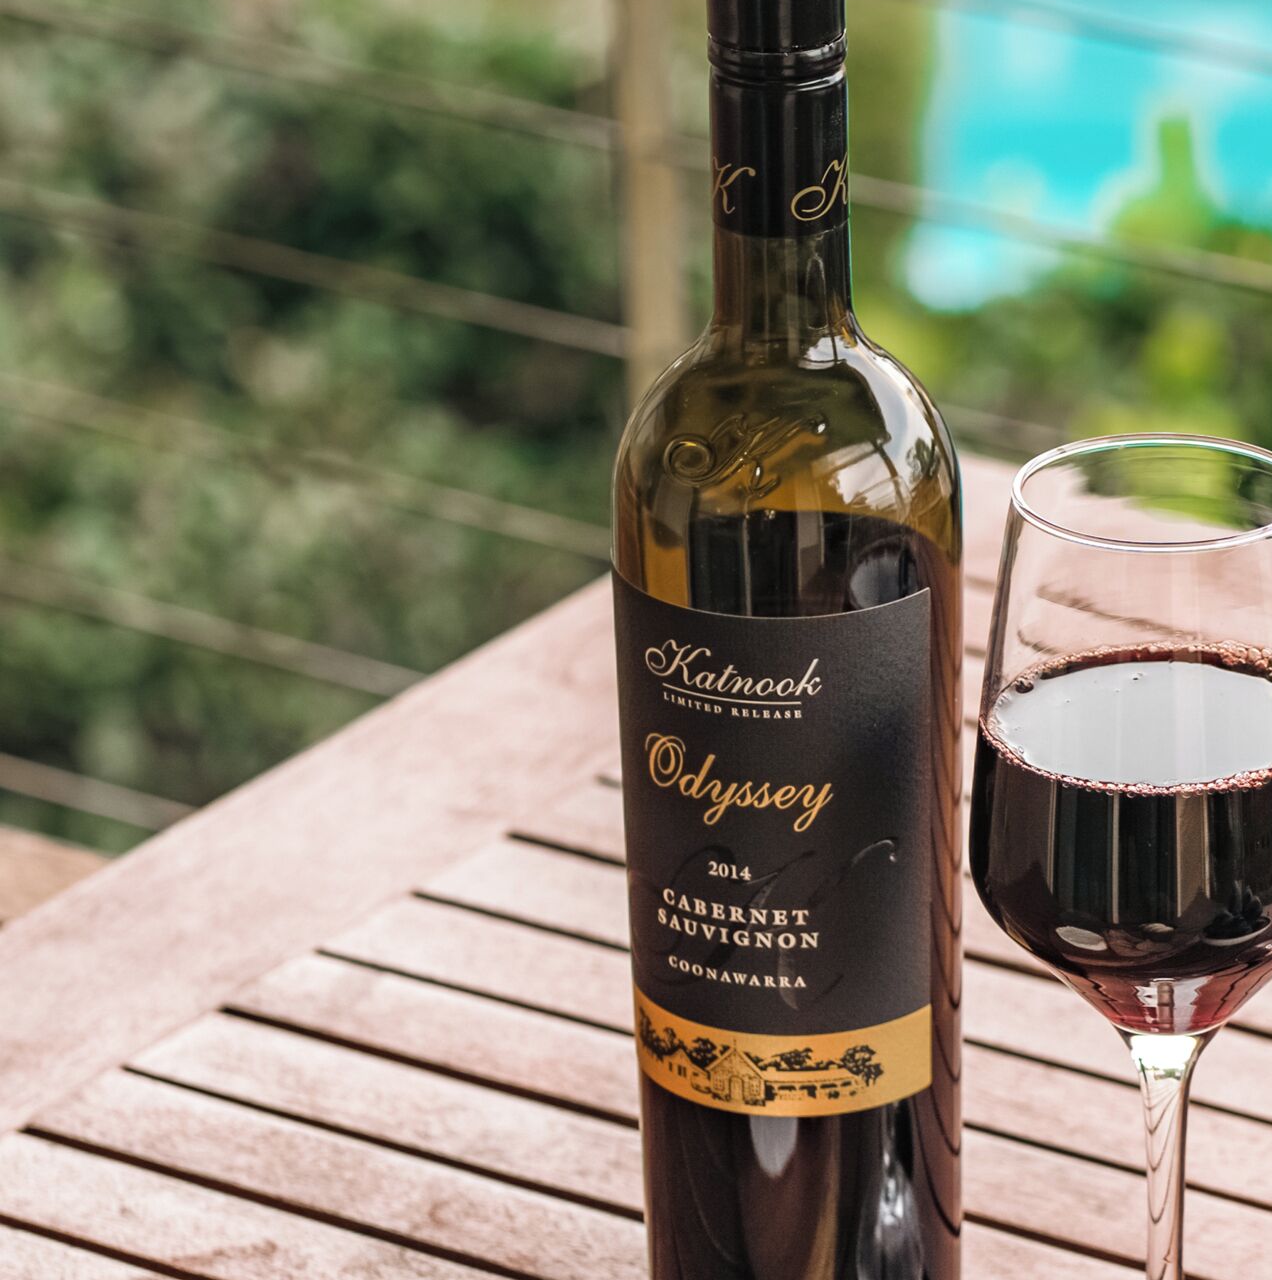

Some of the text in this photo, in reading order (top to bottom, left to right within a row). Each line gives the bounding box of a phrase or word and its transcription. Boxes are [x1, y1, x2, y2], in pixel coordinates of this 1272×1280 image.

[645, 638, 822, 697] Katnook
[662, 691, 803, 720] LIMITED RELEASE
[645, 732, 833, 832] Odyssey
[708, 860, 752, 881] 2014
[662, 887, 809, 926] CABERNET
[657, 908, 820, 948] SAUVIGNON
[668, 954, 807, 988] COONAWARRA
